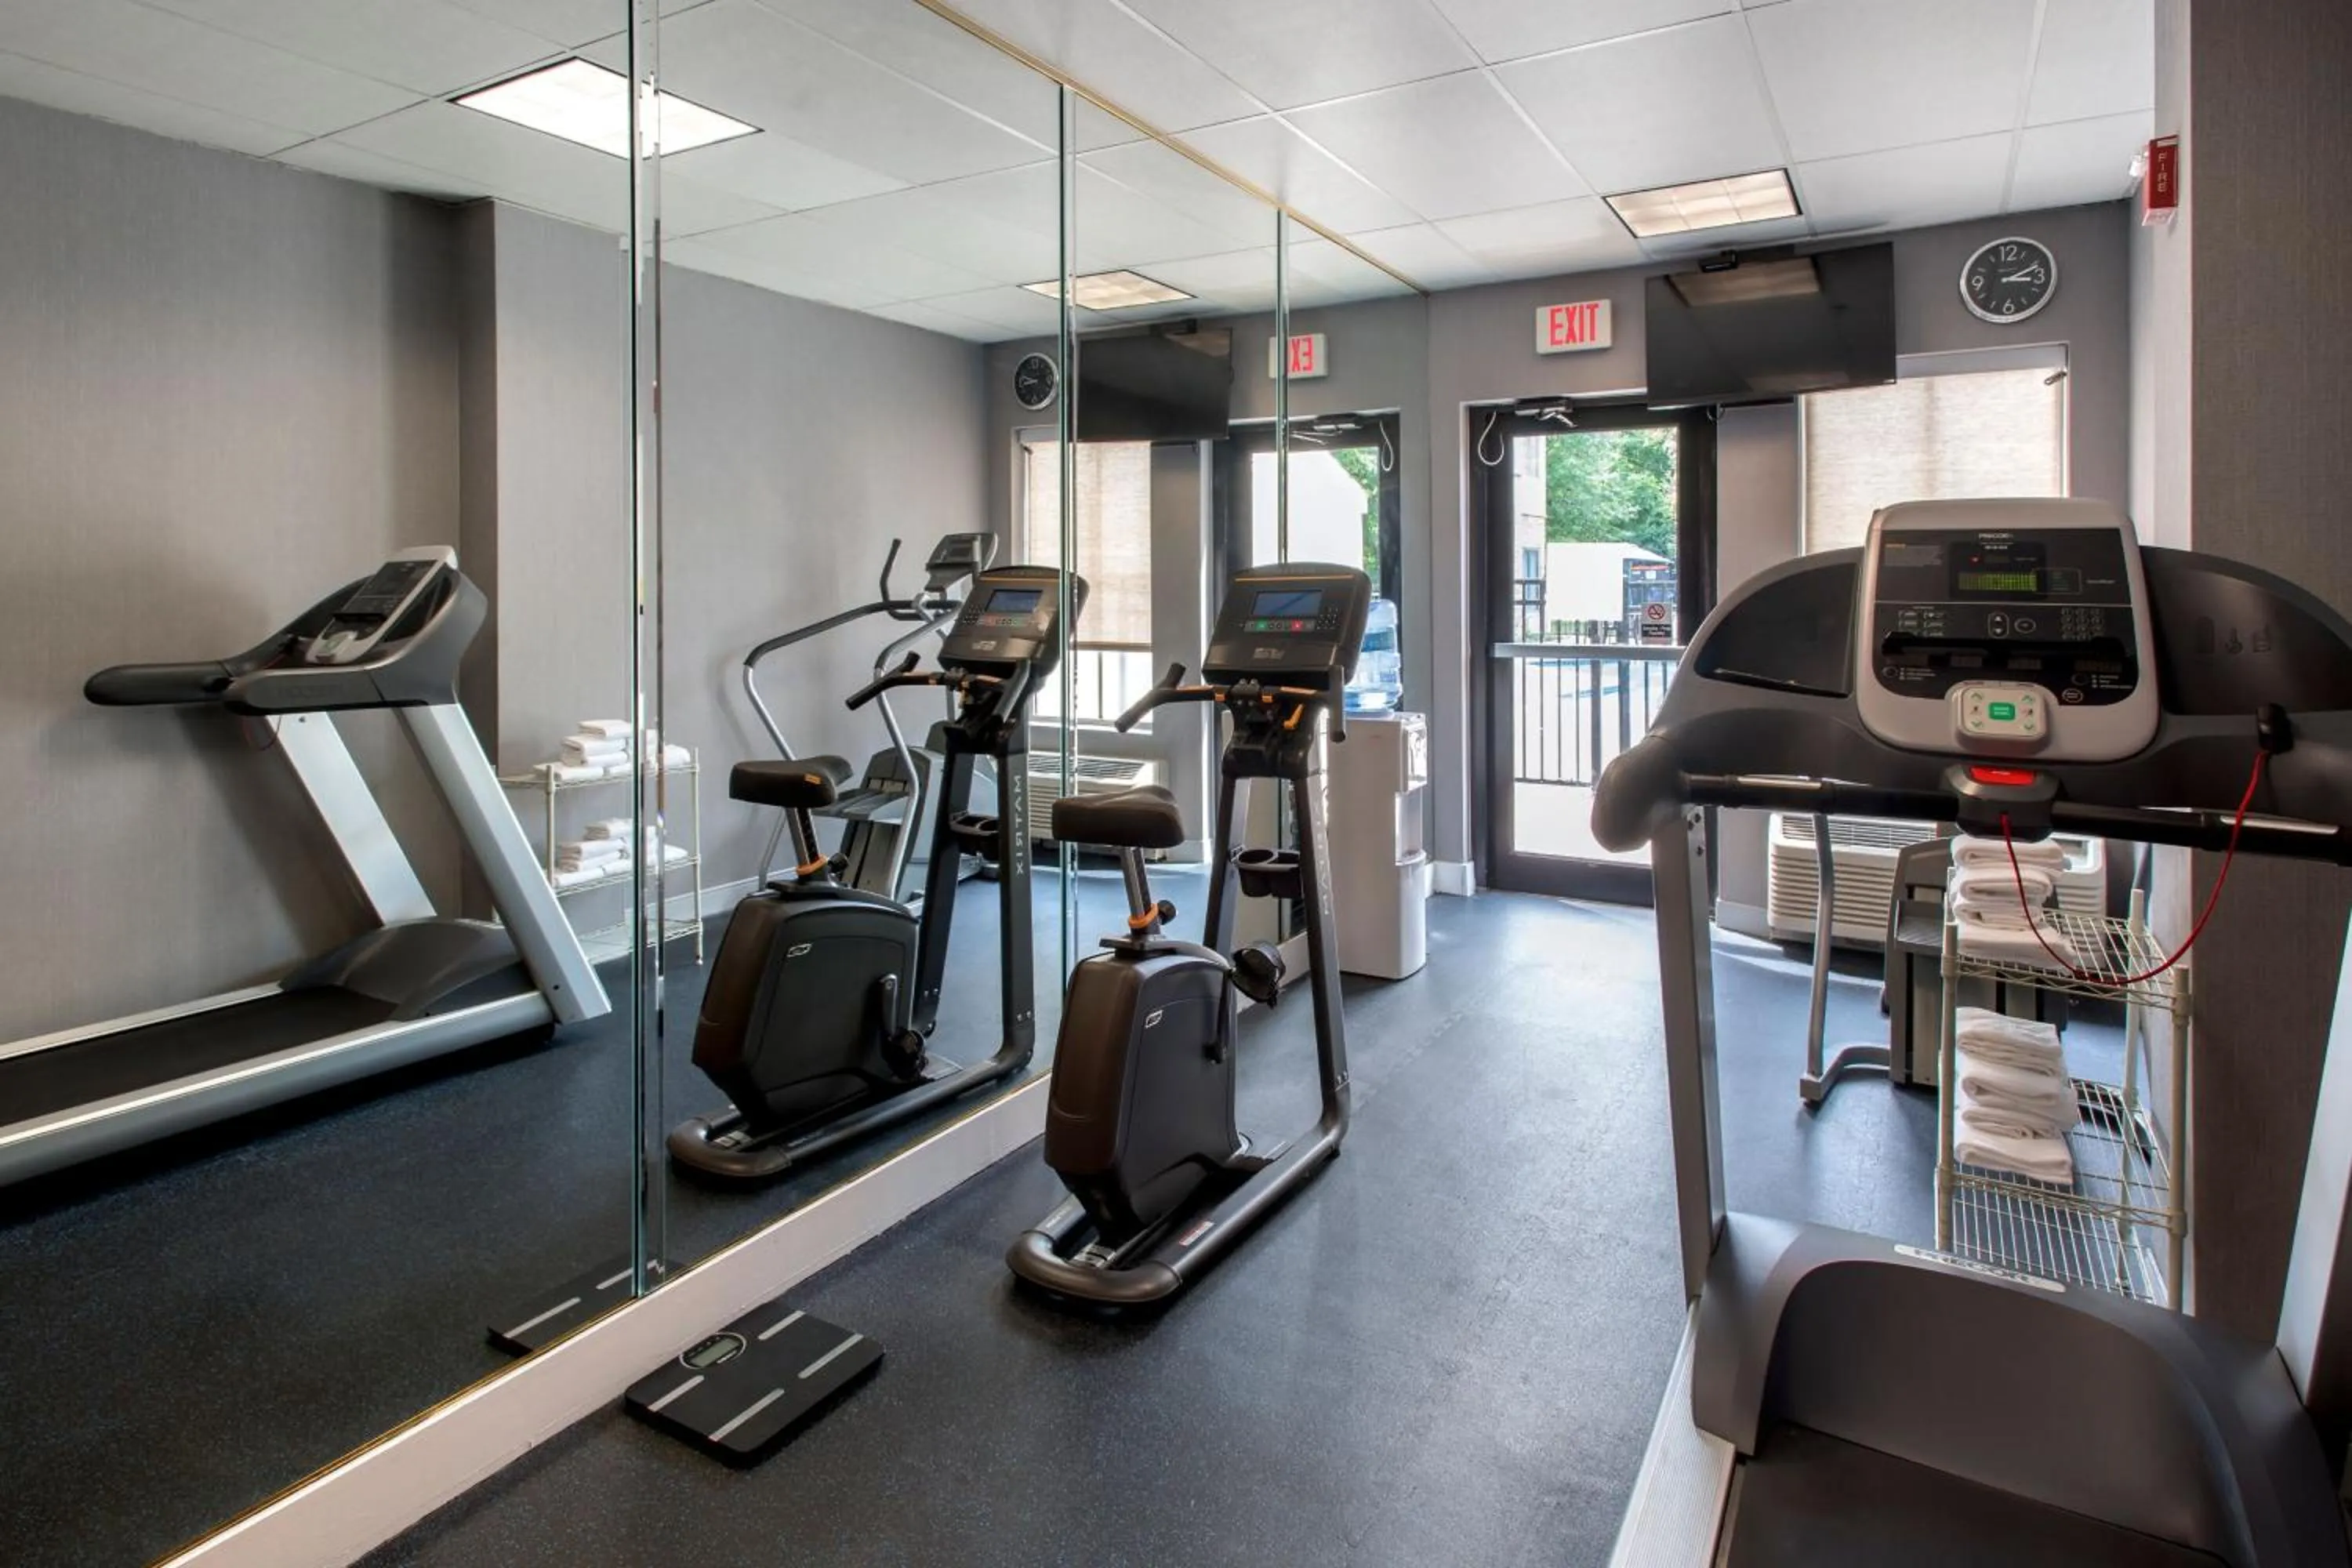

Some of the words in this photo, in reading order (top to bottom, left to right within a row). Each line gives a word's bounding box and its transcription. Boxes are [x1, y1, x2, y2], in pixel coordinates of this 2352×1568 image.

[2157, 151, 2168, 192] FIRE
[1999, 245, 2017, 262] 12
[1971, 275, 1984, 291] 9
[2034, 267, 2045, 285] 3
[2002, 298, 2015, 314] 6
[1550, 303, 1599, 346] EXIT
